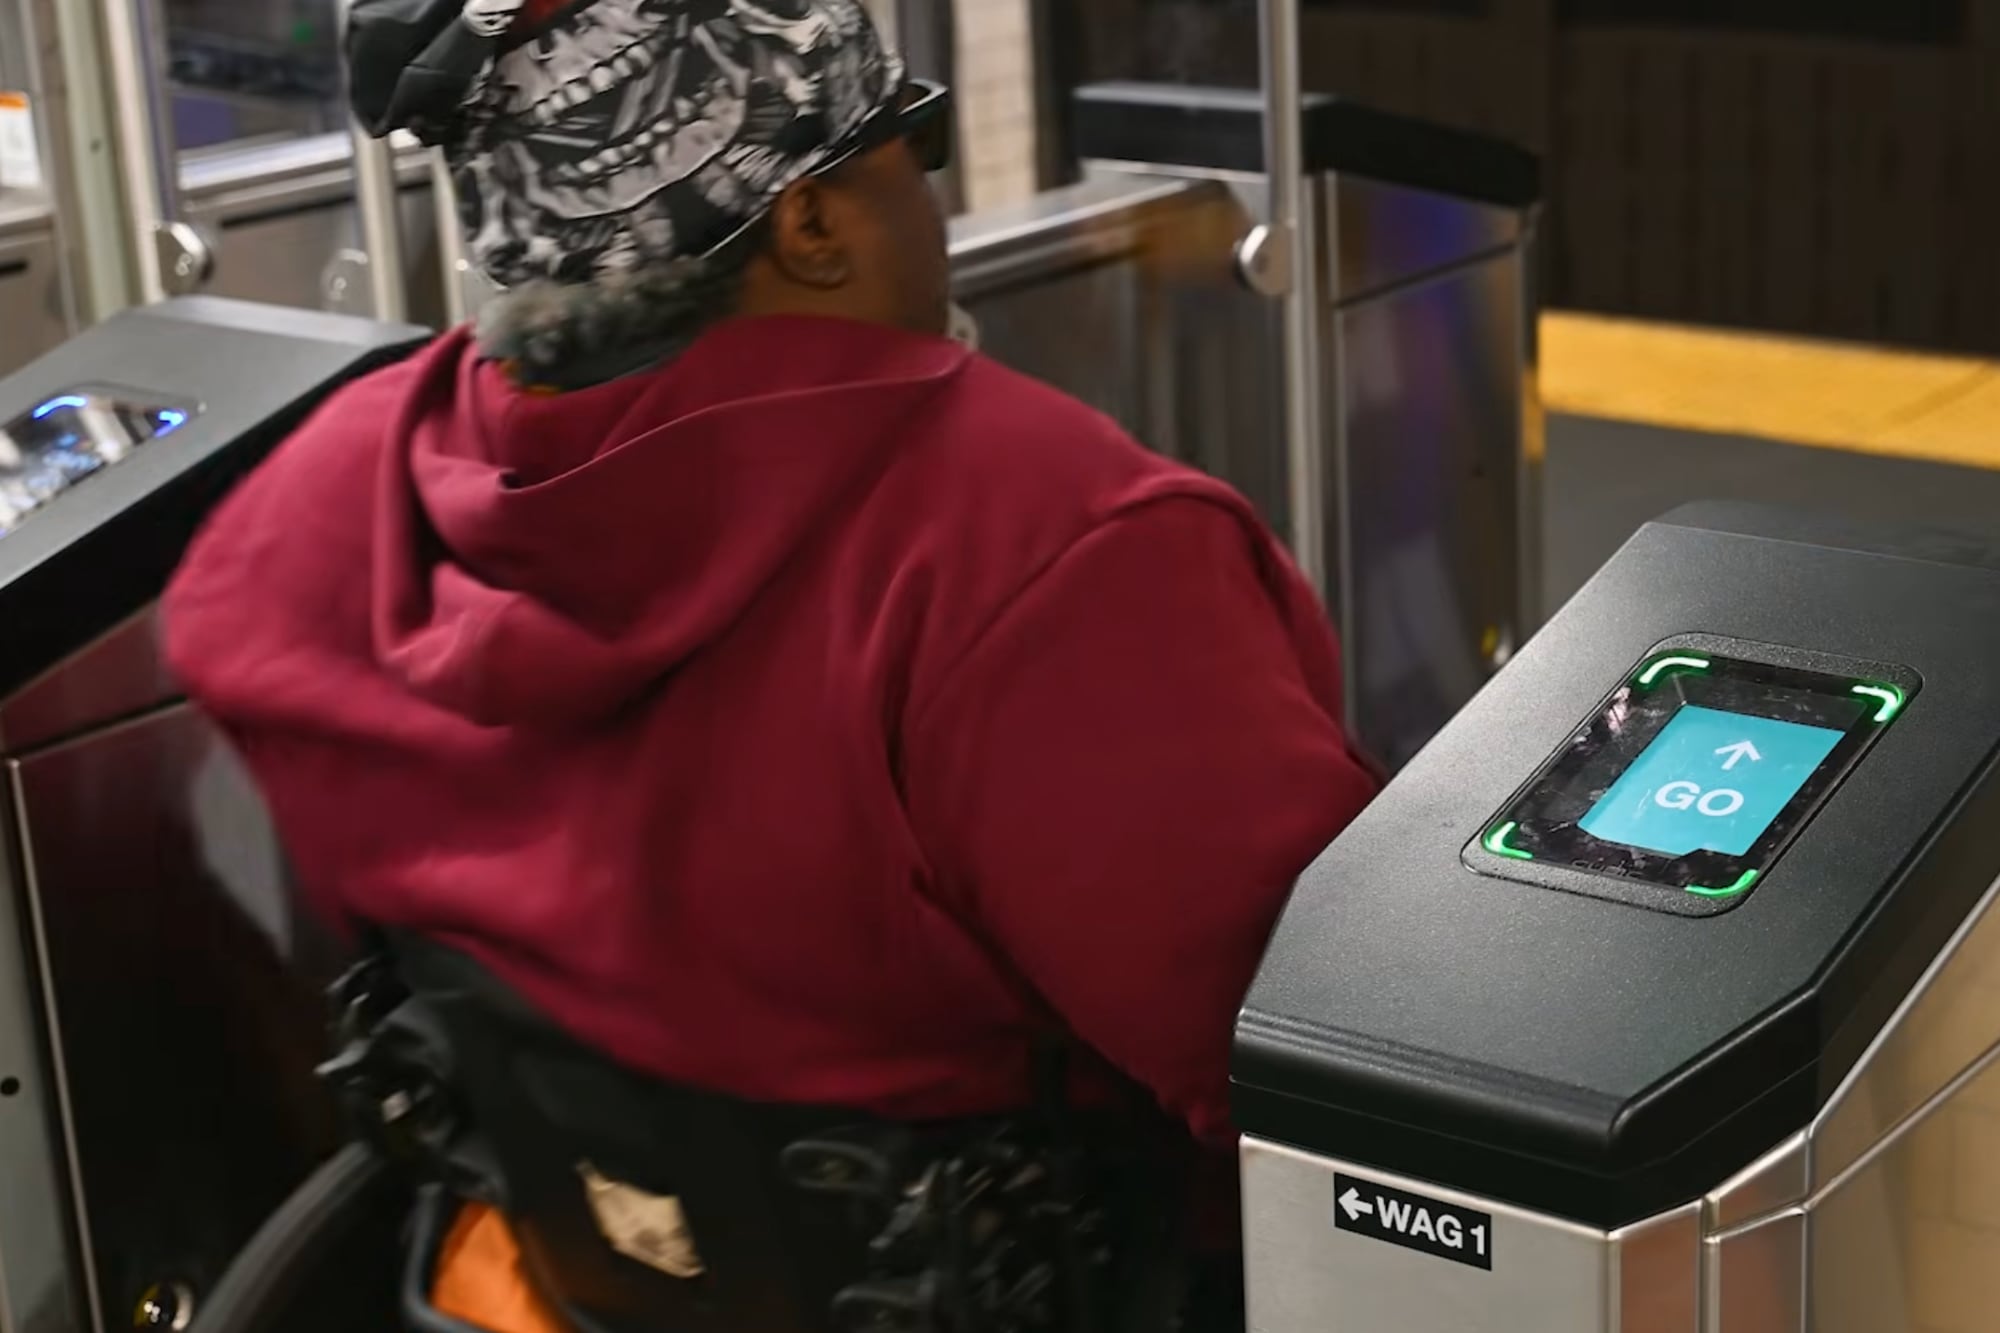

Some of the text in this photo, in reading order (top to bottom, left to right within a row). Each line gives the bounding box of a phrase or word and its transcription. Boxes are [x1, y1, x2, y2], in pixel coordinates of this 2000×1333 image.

[1655, 781, 1743, 816] GO
[1375, 1195, 1485, 1256] WAG 1
